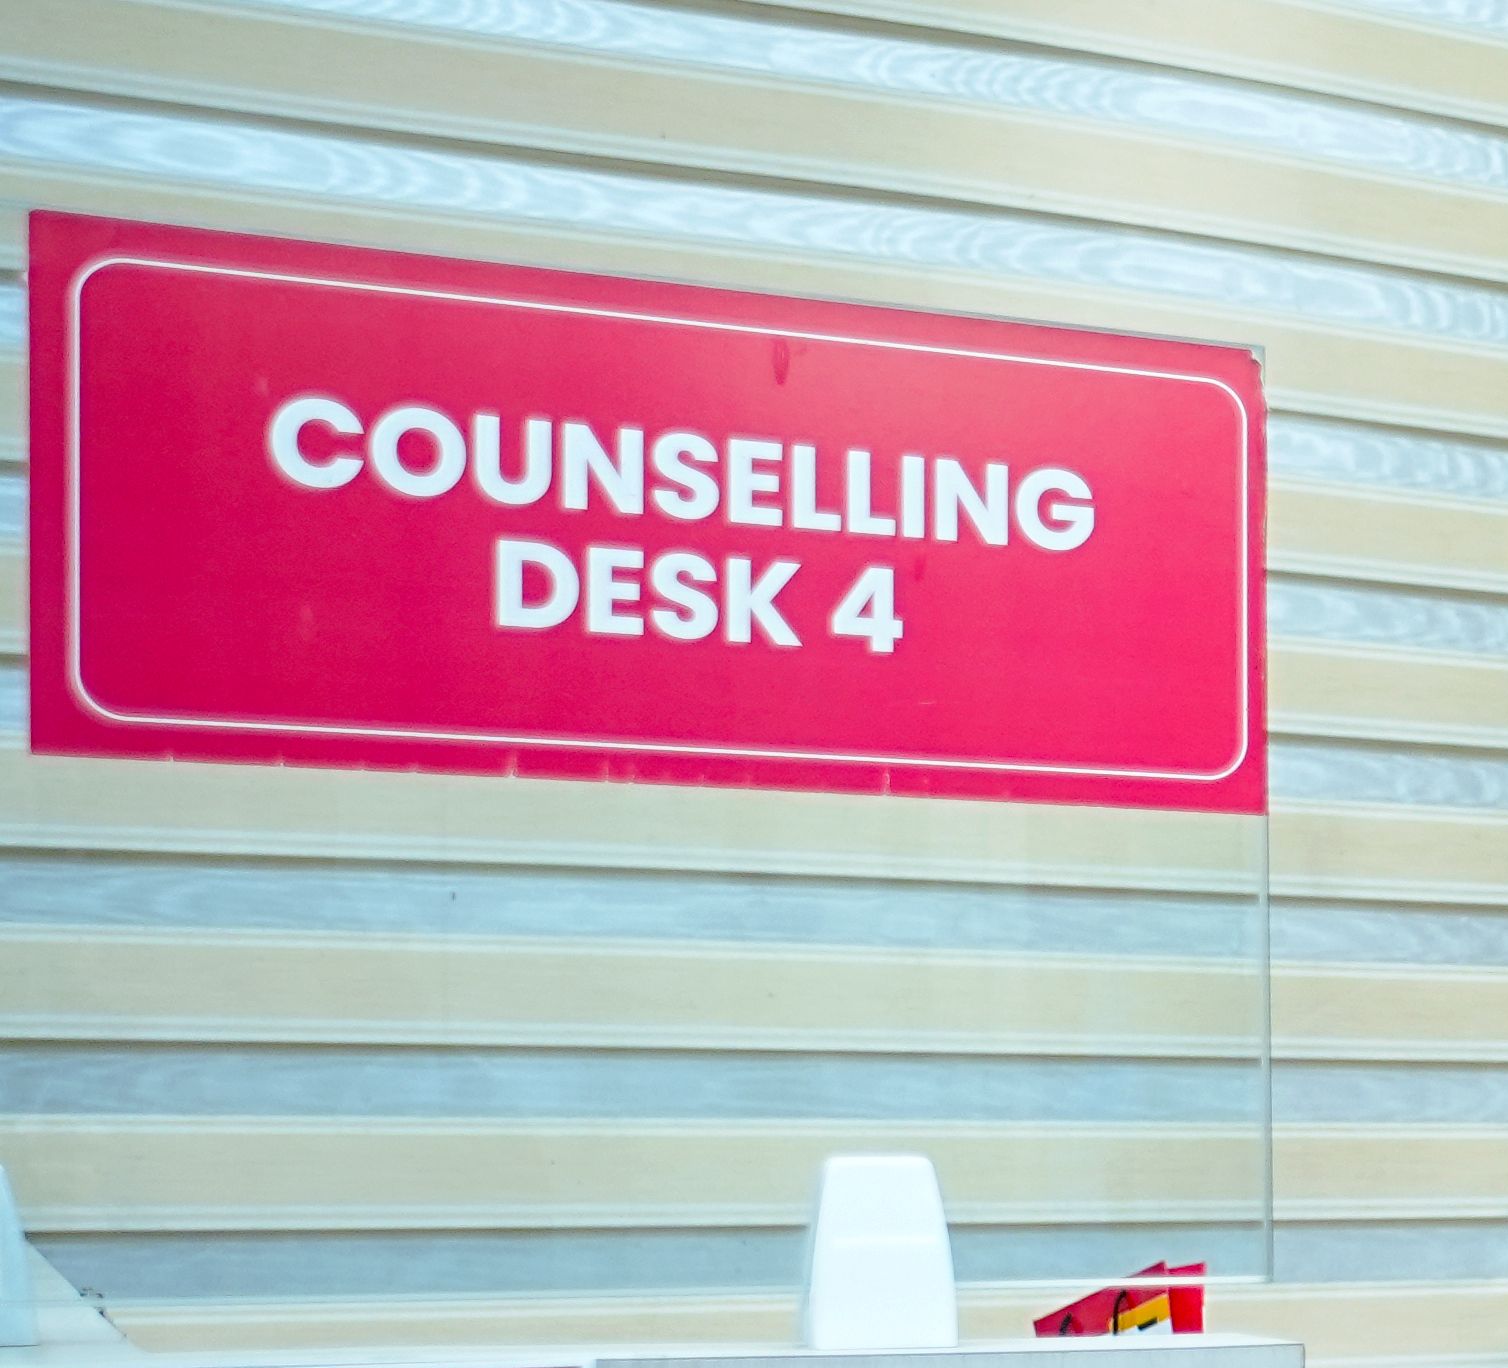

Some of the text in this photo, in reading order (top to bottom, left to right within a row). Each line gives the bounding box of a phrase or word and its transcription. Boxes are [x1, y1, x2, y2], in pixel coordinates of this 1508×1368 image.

[267, 395, 1096, 552] COUNSELLING
[492, 537, 905, 655] DESK 4
